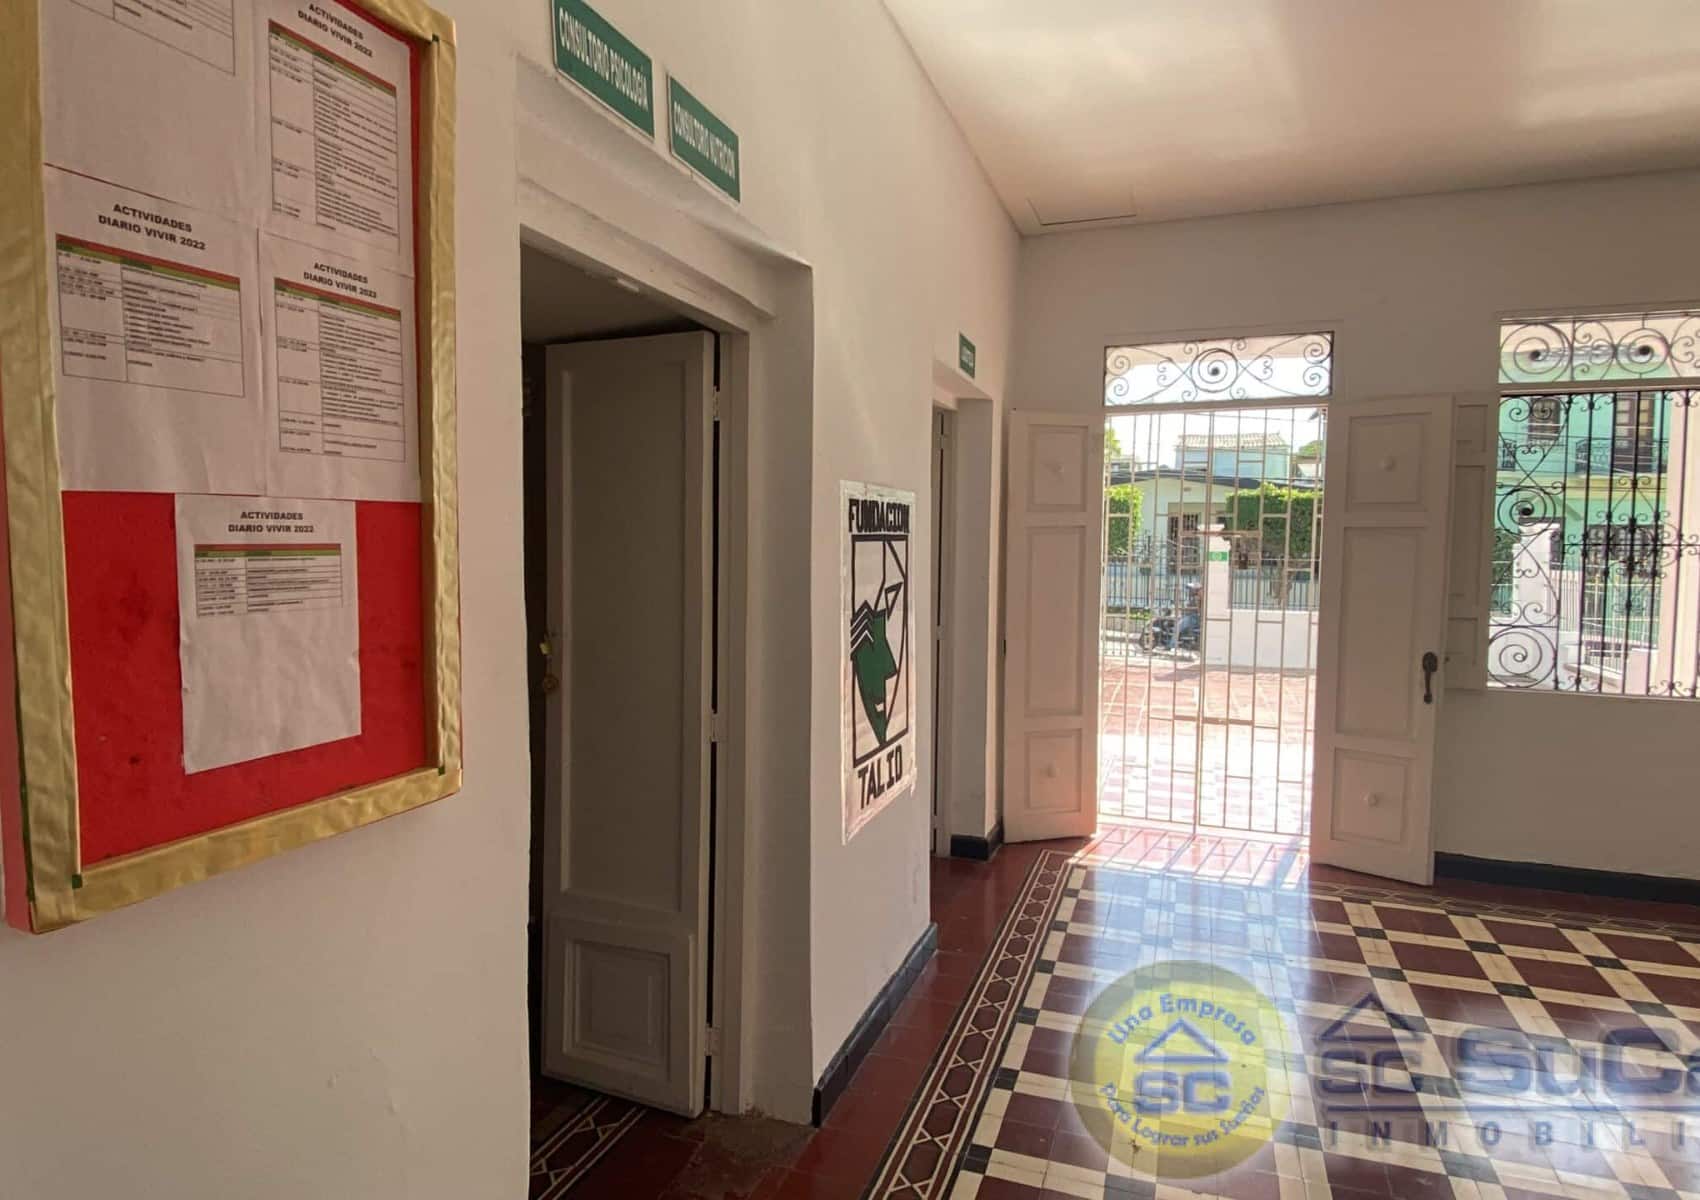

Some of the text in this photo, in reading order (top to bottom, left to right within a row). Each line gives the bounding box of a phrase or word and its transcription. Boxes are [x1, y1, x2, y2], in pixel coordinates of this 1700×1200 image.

[298, 10, 374, 58] DIARIO VIVIR 2022
[309, 3, 364, 40] ACTIVIDADES
[558, 7, 610, 81] CONSULTORIO
[673, 101, 709, 159] CONSULTORIO
[98, 215, 207, 251] DIARIO VIVIR 2022
[113, 203, 193, 233] ACTIVIDADES
[303, 271, 378, 299] DIARIO VIVIR 2022
[313, 262, 369, 284] ACTIVIDADES
[227, 524, 315, 533] DIARIO VIVIR 2022
[240, 511, 304, 521] ACTIVIDADES
[848, 498, 910, 534] FUNDACION
